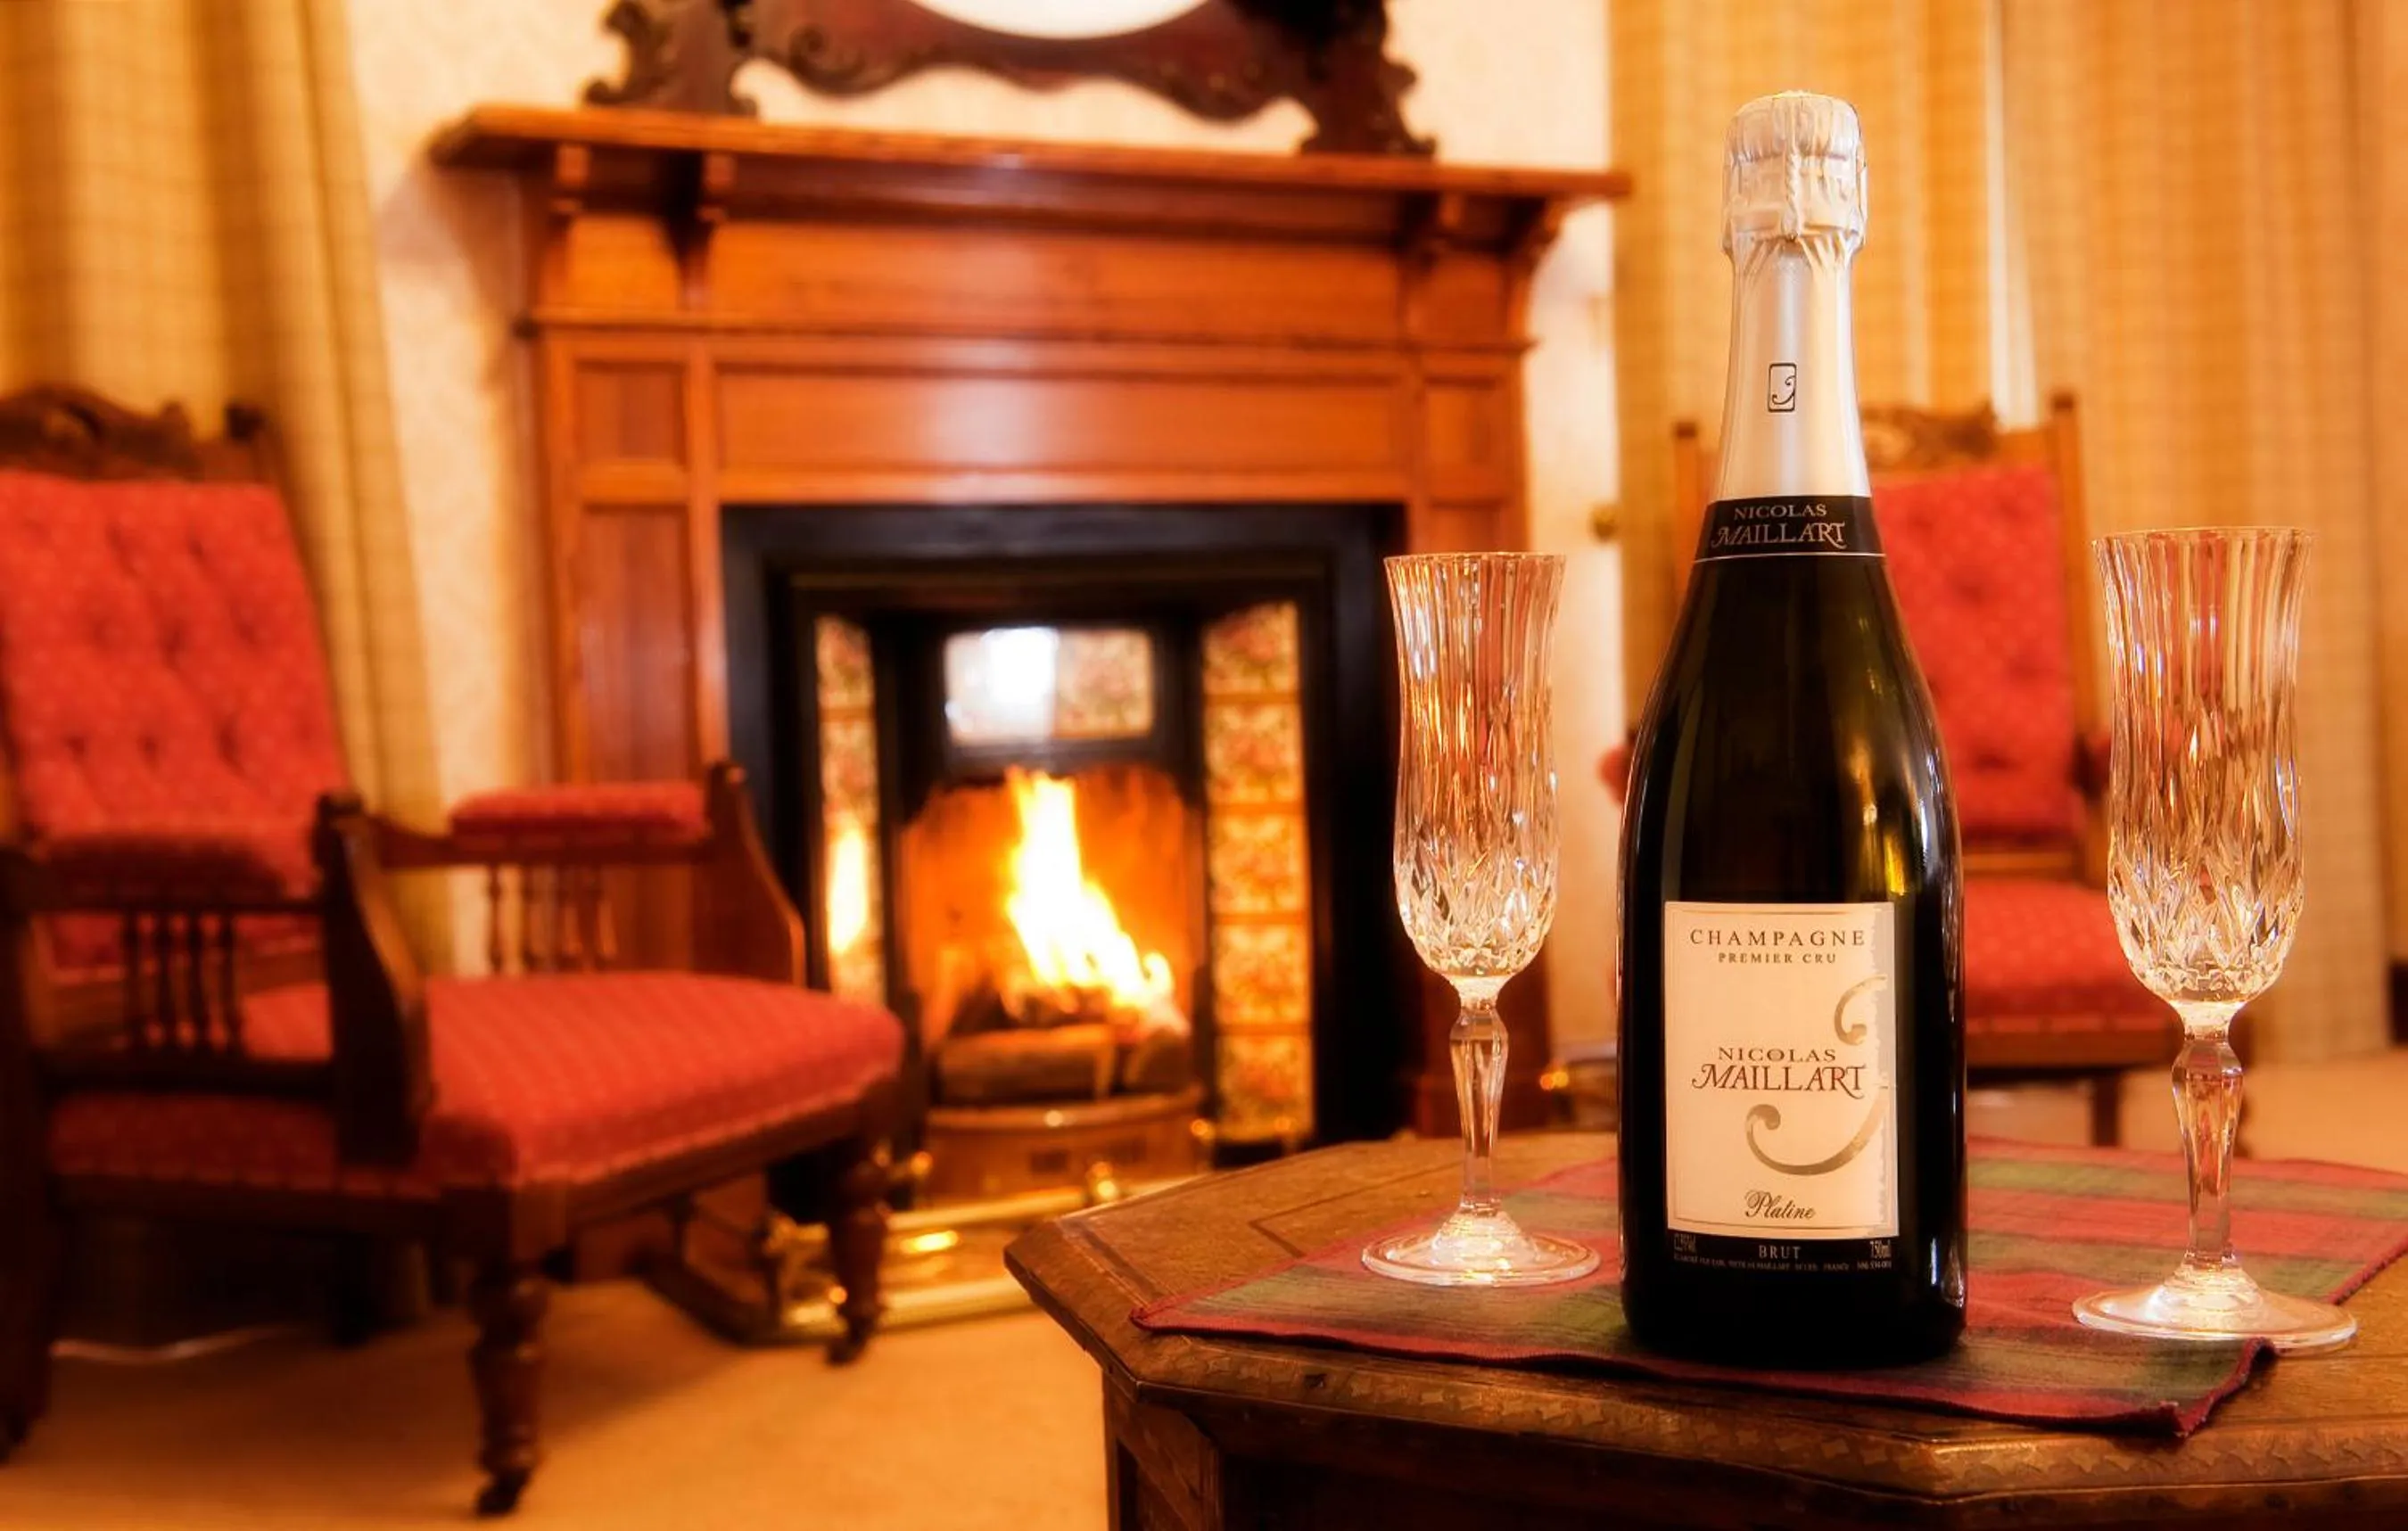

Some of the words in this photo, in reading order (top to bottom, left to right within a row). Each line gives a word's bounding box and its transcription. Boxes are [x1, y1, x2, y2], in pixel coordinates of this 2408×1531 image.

[1733, 503, 1827, 521] NICOLAS
[1711, 522, 1848, 549] MAILLART
[1689, 928, 1865, 947] CHAMPAGNE
[1718, 952, 1793, 964] PREMIER
[1802, 952, 1837, 964] CRU
[1718, 1046, 1836, 1063] NICOLAS
[1691, 1063, 1866, 1100] MAILLART
[1744, 1189, 1816, 1220] Platine
[1758, 1245, 1802, 1260] BRUT
